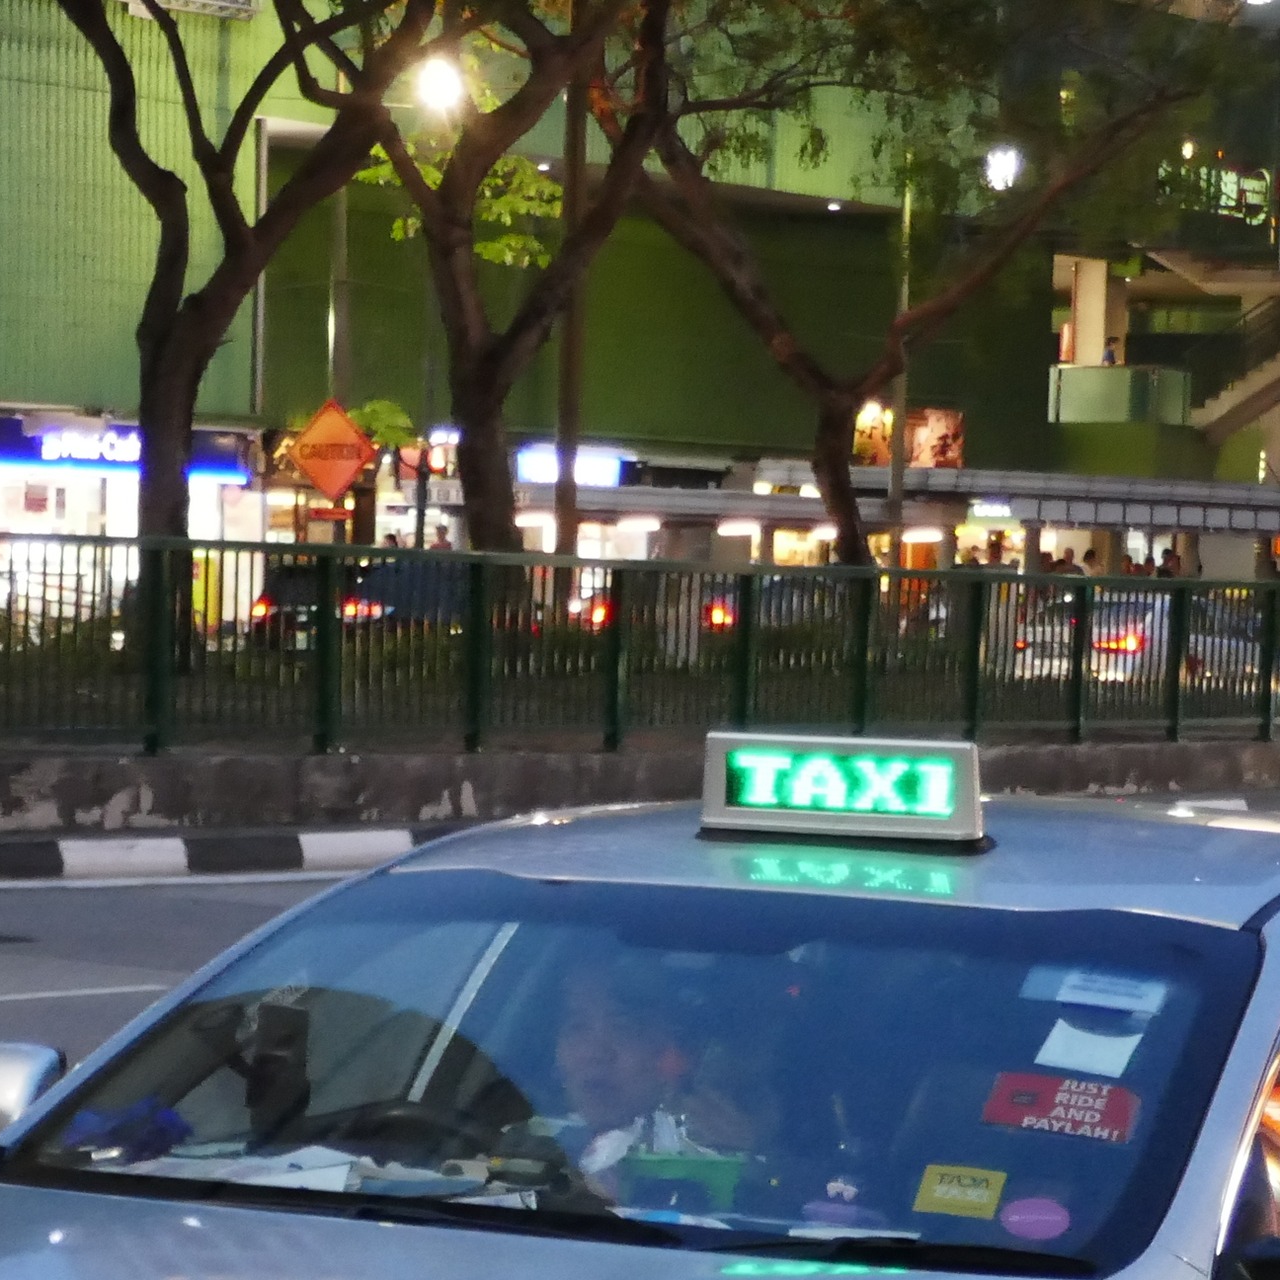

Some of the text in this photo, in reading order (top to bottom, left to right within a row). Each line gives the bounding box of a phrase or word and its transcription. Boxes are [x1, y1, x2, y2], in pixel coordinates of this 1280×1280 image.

[734, 754, 954, 816] TAXI
[1059, 1079, 1112, 1096] JUST
[1054, 1092, 1108, 1110] RIDE
[1050, 1106, 1101, 1123] AND
[1021, 1116, 1121, 1142] PAYLAH!
